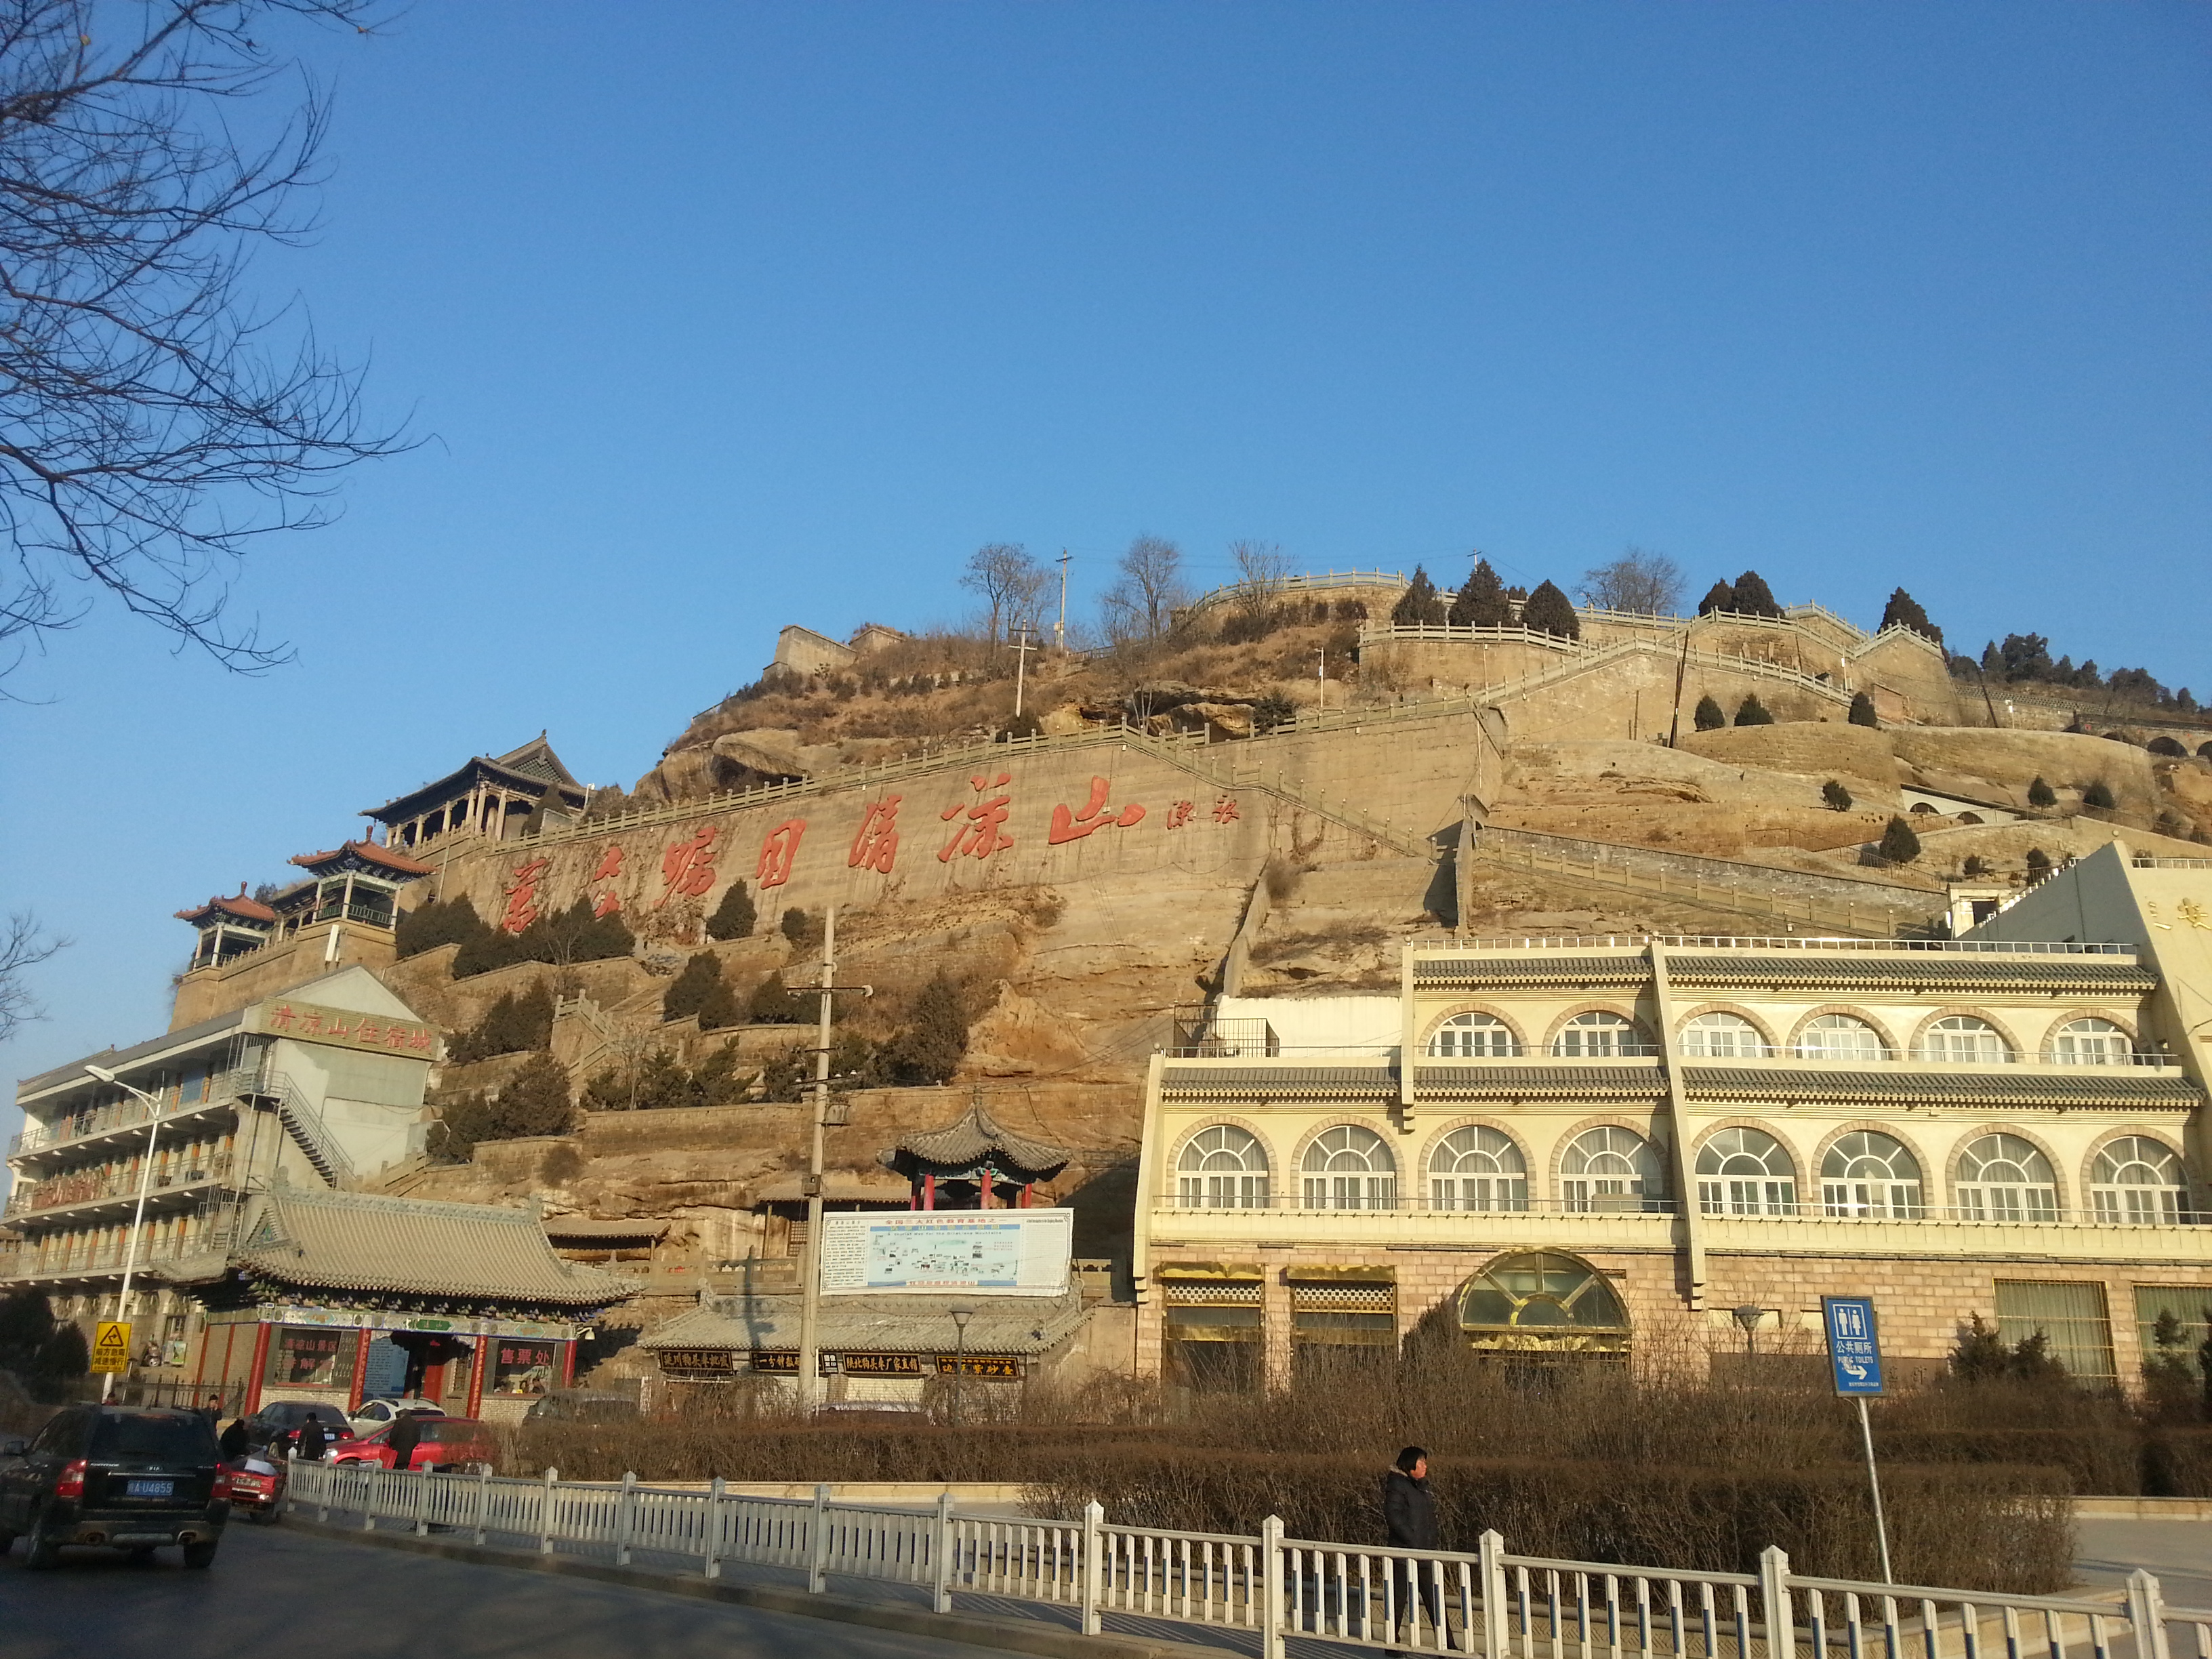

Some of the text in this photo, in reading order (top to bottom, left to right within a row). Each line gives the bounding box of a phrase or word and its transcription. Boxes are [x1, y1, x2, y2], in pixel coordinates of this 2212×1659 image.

[270, 1004, 432, 1055] 清凉山住宿城
[285, 1338, 337, 1352] 清凉山景区
[1836, 1340, 1872, 1354] 公共厕所
[501, 1348, 550, 1366] 售票处
